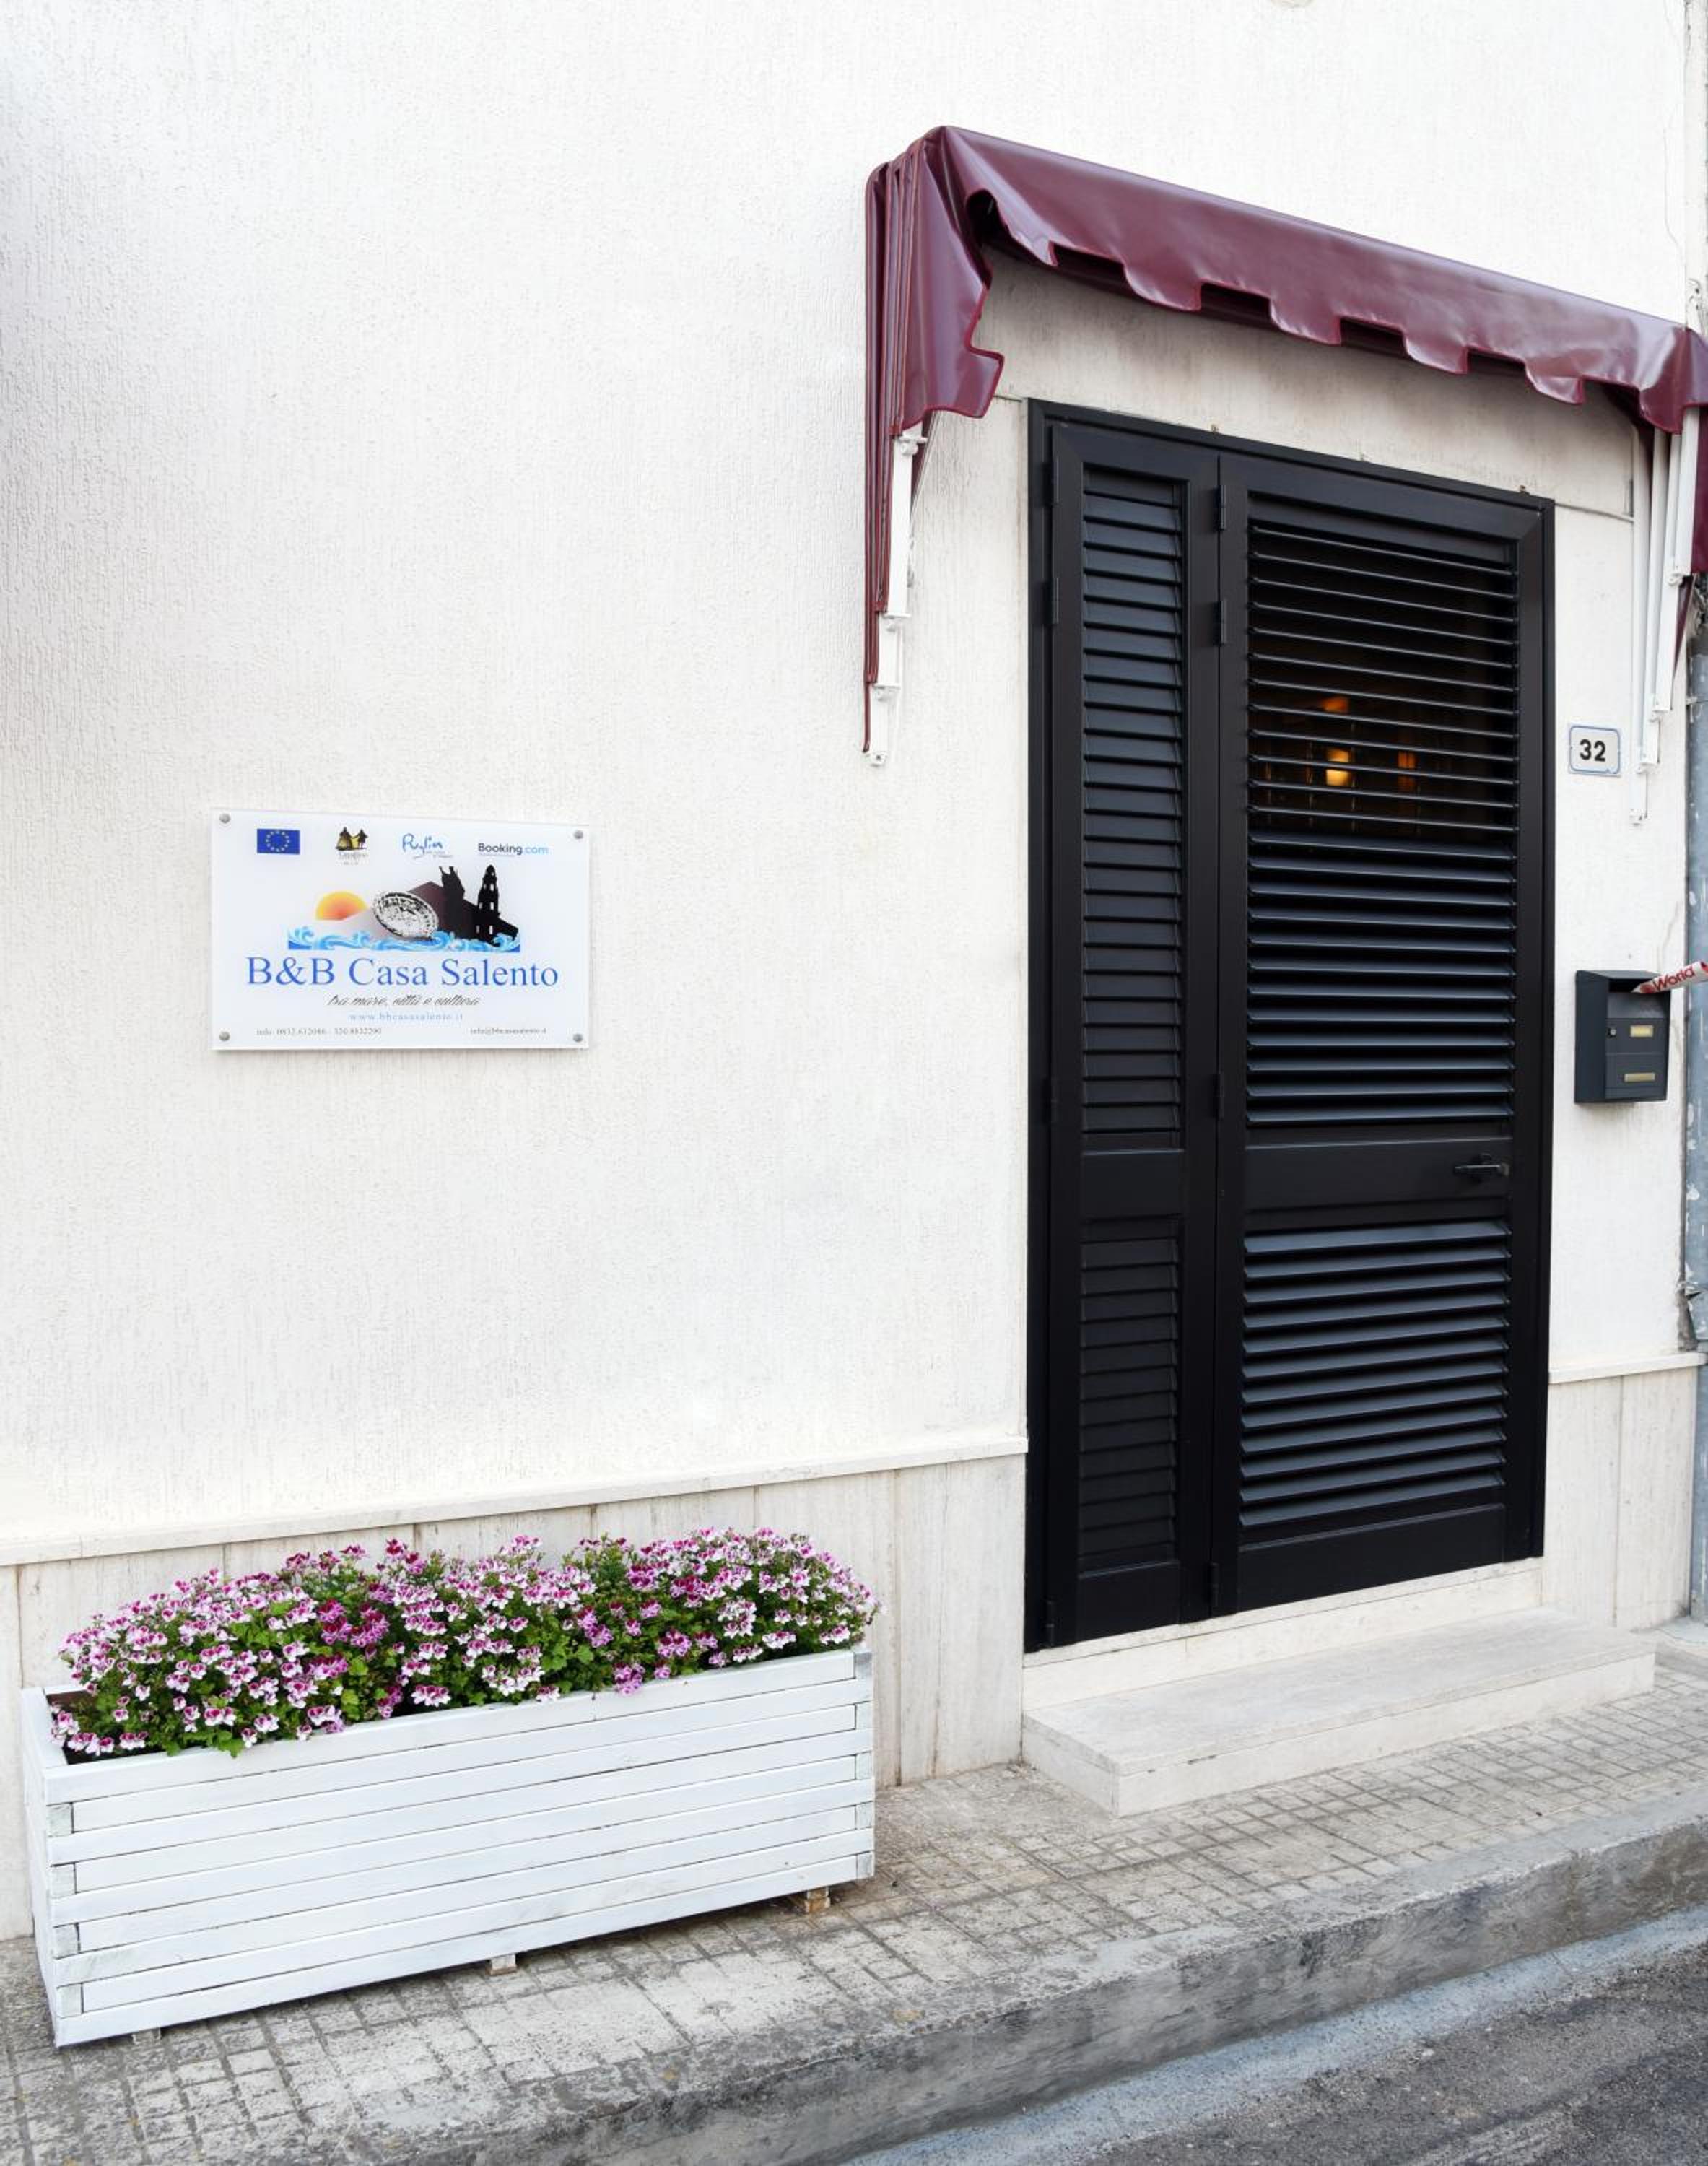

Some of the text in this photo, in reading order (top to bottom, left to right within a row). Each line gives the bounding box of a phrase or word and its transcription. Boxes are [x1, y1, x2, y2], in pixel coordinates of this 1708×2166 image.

[1580, 739, 1605, 762] 32
[478, 843, 549, 856] Booking.com
[247, 957, 559, 986] B&B Casa Salento
[1652, 966, 1696, 991] World
